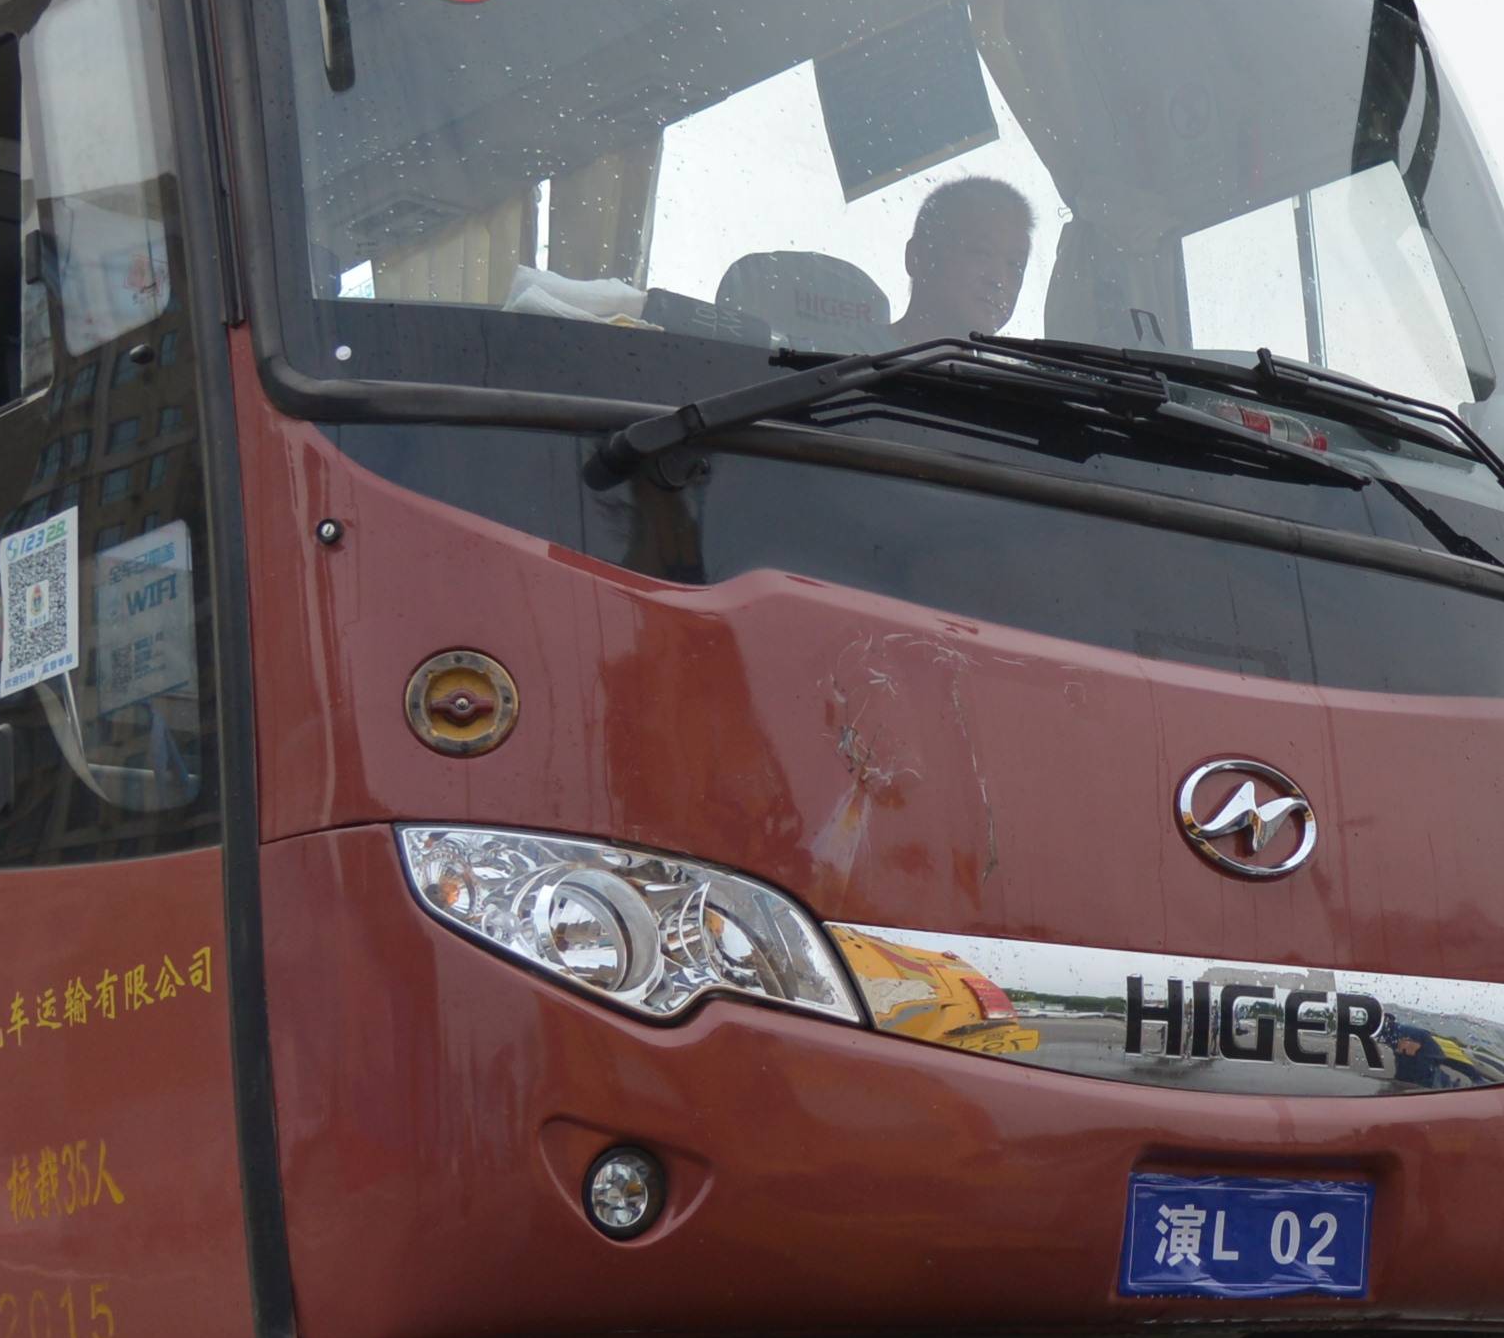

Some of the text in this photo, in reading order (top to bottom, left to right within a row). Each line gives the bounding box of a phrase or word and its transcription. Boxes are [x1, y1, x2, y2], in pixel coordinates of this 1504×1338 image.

[127, 573, 177, 615] WIFI
[1125, 975, 1385, 1069] HIGER
[7, 1138, 125, 1223] 核载35人
[1153, 1204, 1337, 1267] 演L 02
